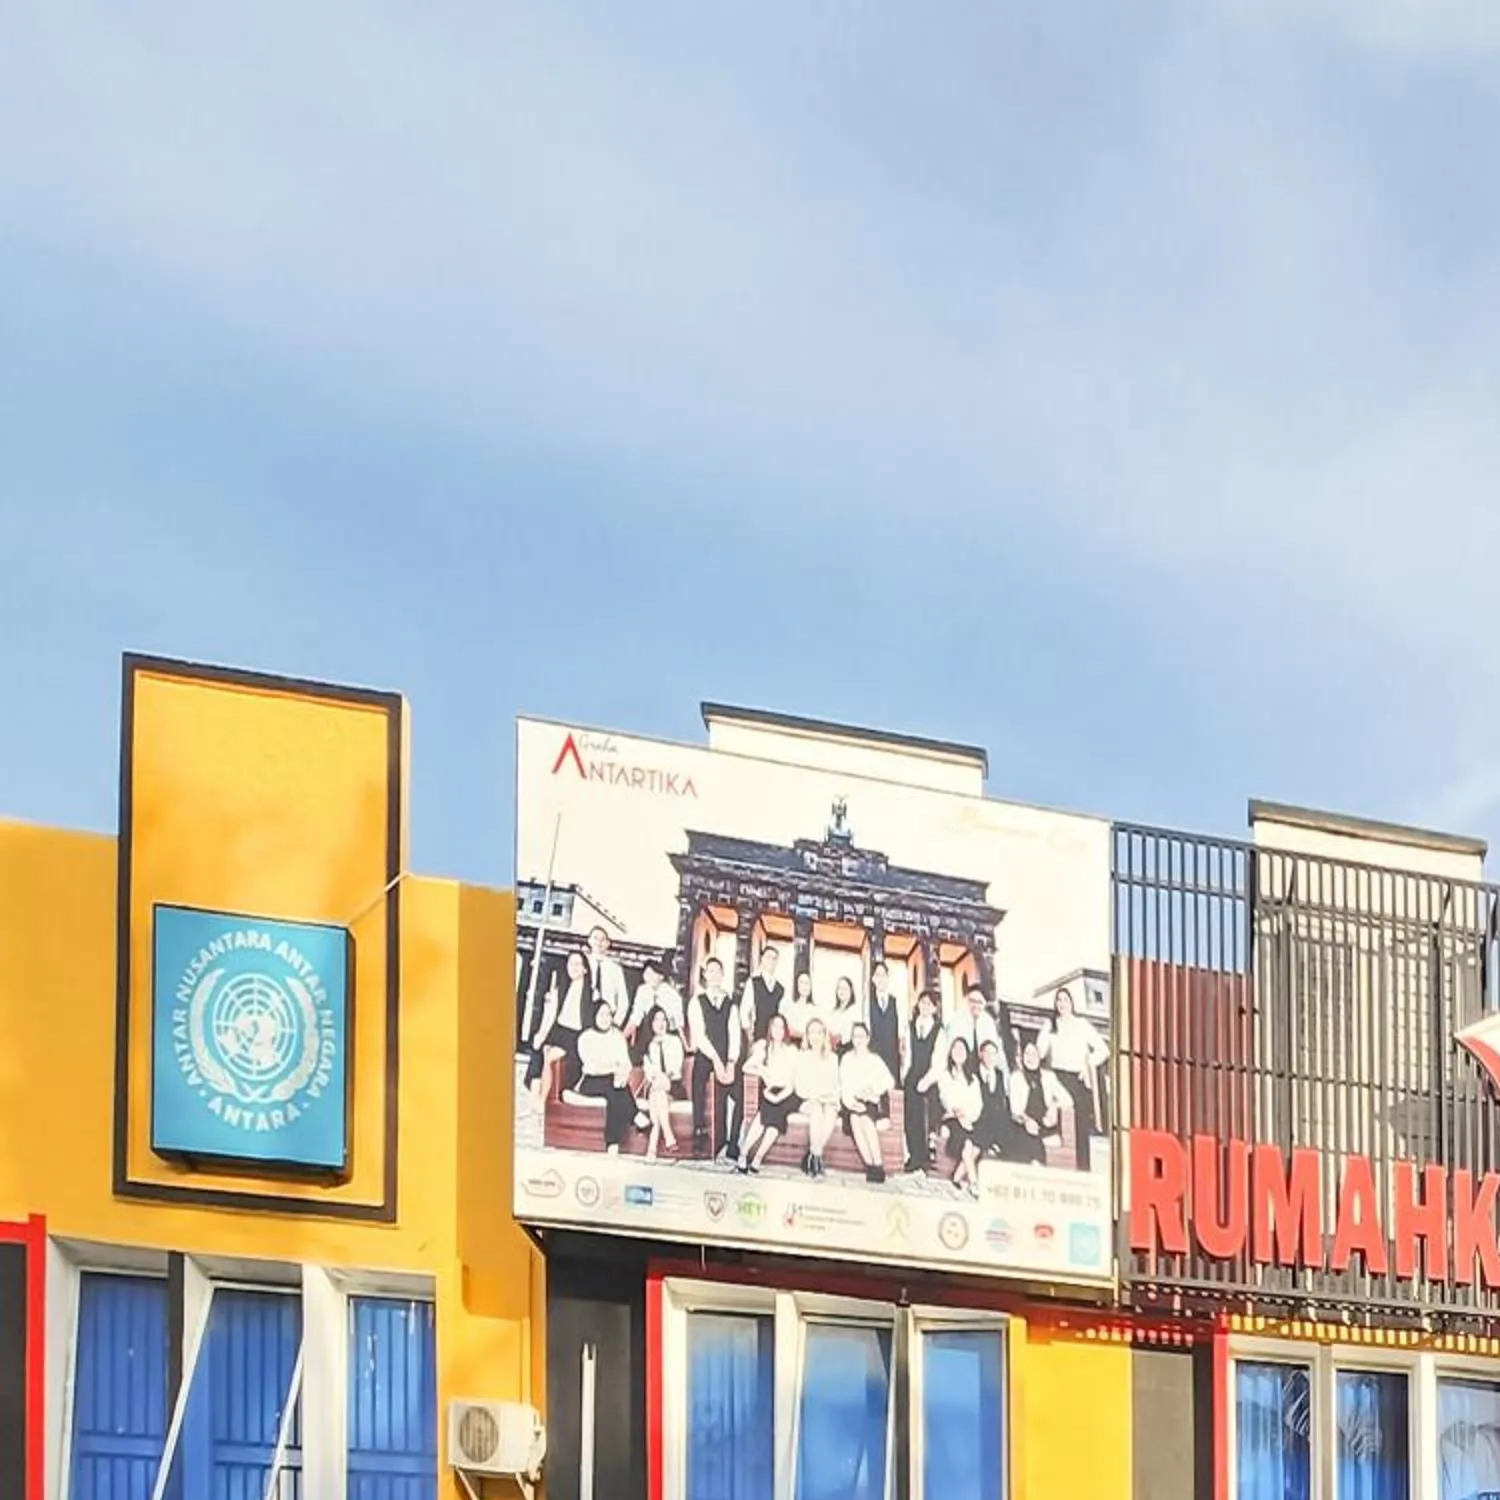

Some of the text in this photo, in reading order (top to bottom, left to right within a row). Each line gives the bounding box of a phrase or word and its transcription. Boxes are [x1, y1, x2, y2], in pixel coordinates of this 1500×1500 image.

[551, 732, 698, 798] ANTARTIKA
[172, 929, 336, 1098] ANTAR NUSANTARA ANTAR NEGARA
[207, 1096, 301, 1132] ANTARA
